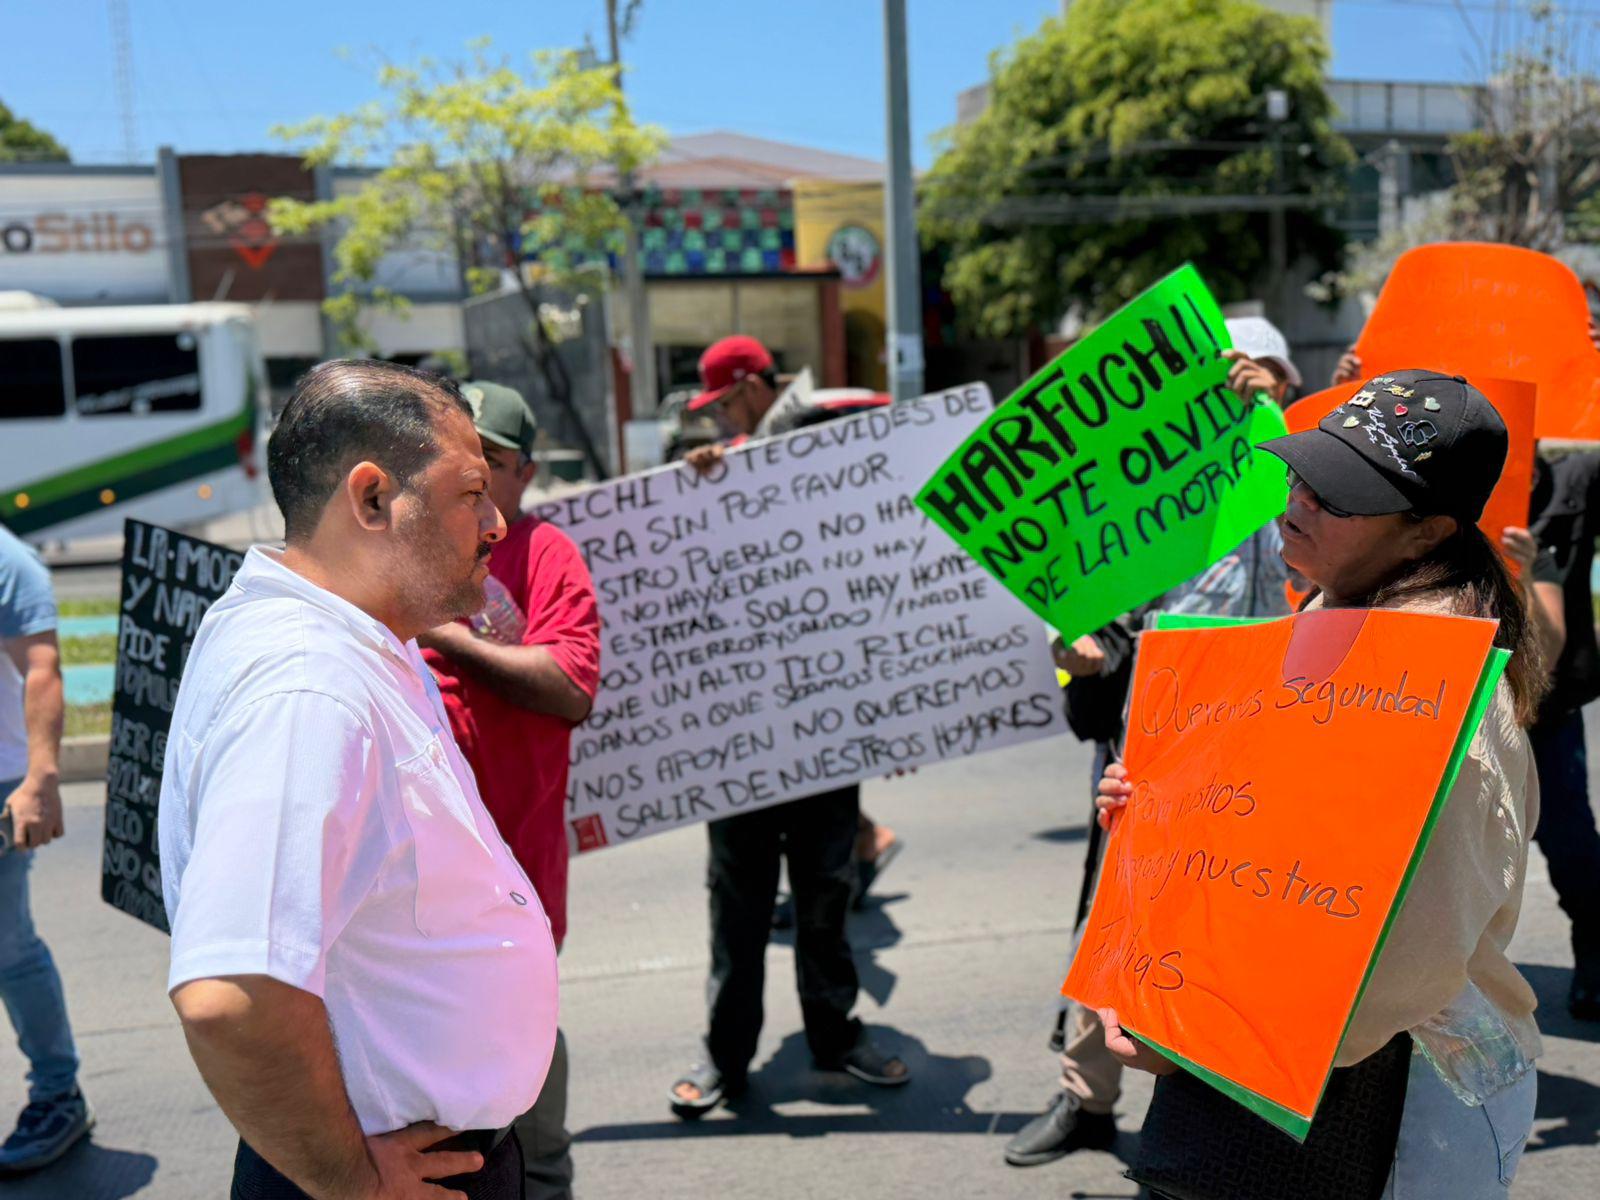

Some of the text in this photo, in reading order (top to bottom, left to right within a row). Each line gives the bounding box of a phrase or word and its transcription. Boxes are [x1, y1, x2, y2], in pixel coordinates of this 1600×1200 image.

[736, 440, 782, 473] TE
[787, 403, 935, 458] OLVIDES
[944, 388, 986, 417] DE
[923, 293, 1222, 535] HARFUCH!!
[647, 509, 708, 554] SIN
[719, 484, 787, 524] POR
[981, 383, 1256, 580] NO TE OLVID
[1024, 435, 1253, 608] DE LA MORA
[600, 565, 678, 605] STRO
[681, 529, 804, 583] PUEBLO
[818, 513, 866, 541] NO
[621, 601, 660, 624] NO
[667, 586, 712, 616] HAY
[822, 548, 864, 571] NO
[874, 536, 927, 561] HAY
[746, 587, 829, 628] SOLO
[847, 573, 900, 624] HAY
[652, 679, 691, 708] UN
[699, 660, 766, 694] ALTO
[776, 650, 845, 690] TIO
[855, 614, 976, 664] RICHI
[681, 712, 700, 731] A
[707, 691, 763, 727] QUE
[879, 625, 1029, 681] ESCUCHADOS
[656, 726, 775, 783] APOYEN
[793, 707, 844, 741] NO
[854, 659, 1028, 726] QUEREMOS
[616, 784, 716, 838] SALIR
[716, 769, 775, 807] DE
[779, 732, 926, 790] NUESTROS
[1184, 849, 1363, 918] nuestras
